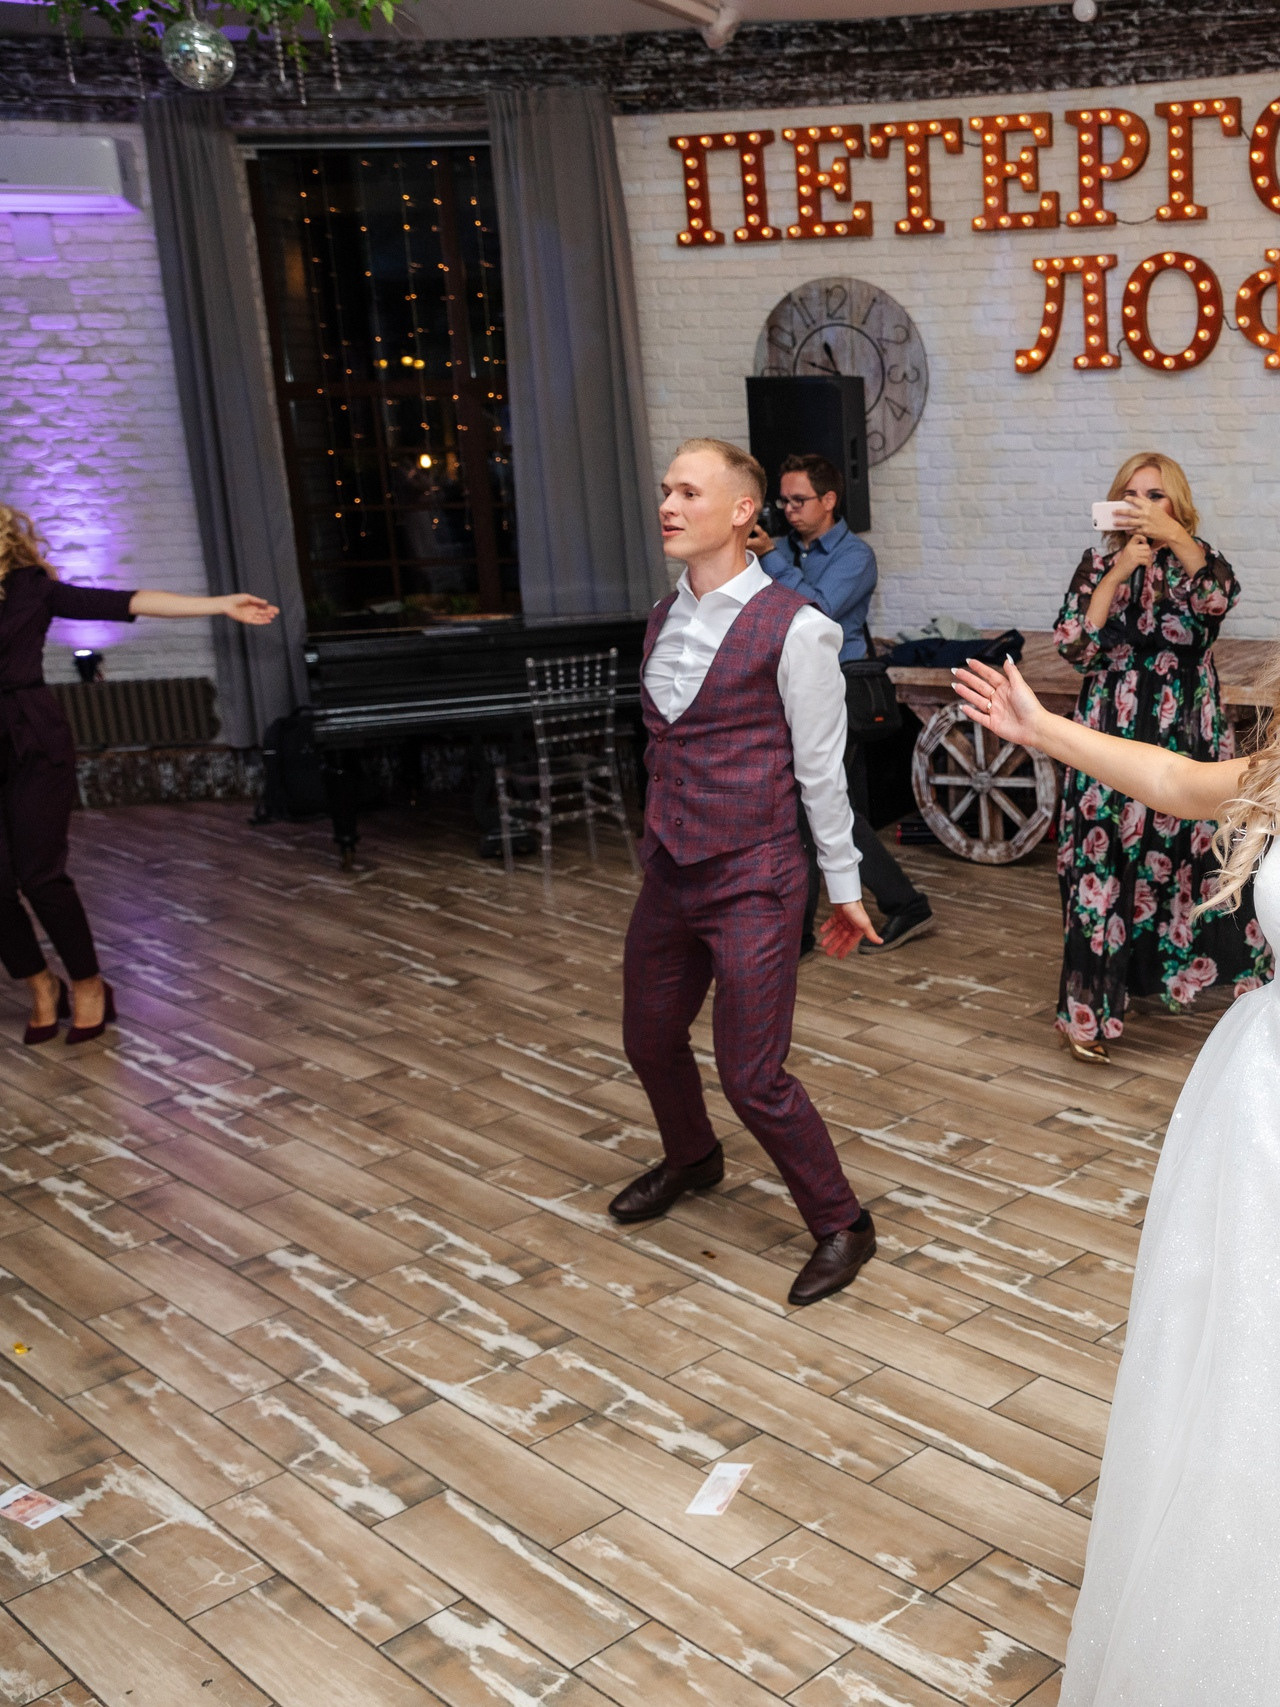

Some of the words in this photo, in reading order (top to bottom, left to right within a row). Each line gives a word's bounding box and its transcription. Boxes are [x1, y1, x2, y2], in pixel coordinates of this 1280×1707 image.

[876, 324, 910, 354] 2
[887, 364, 920, 384] 3
[884, 396, 911, 421] 4
